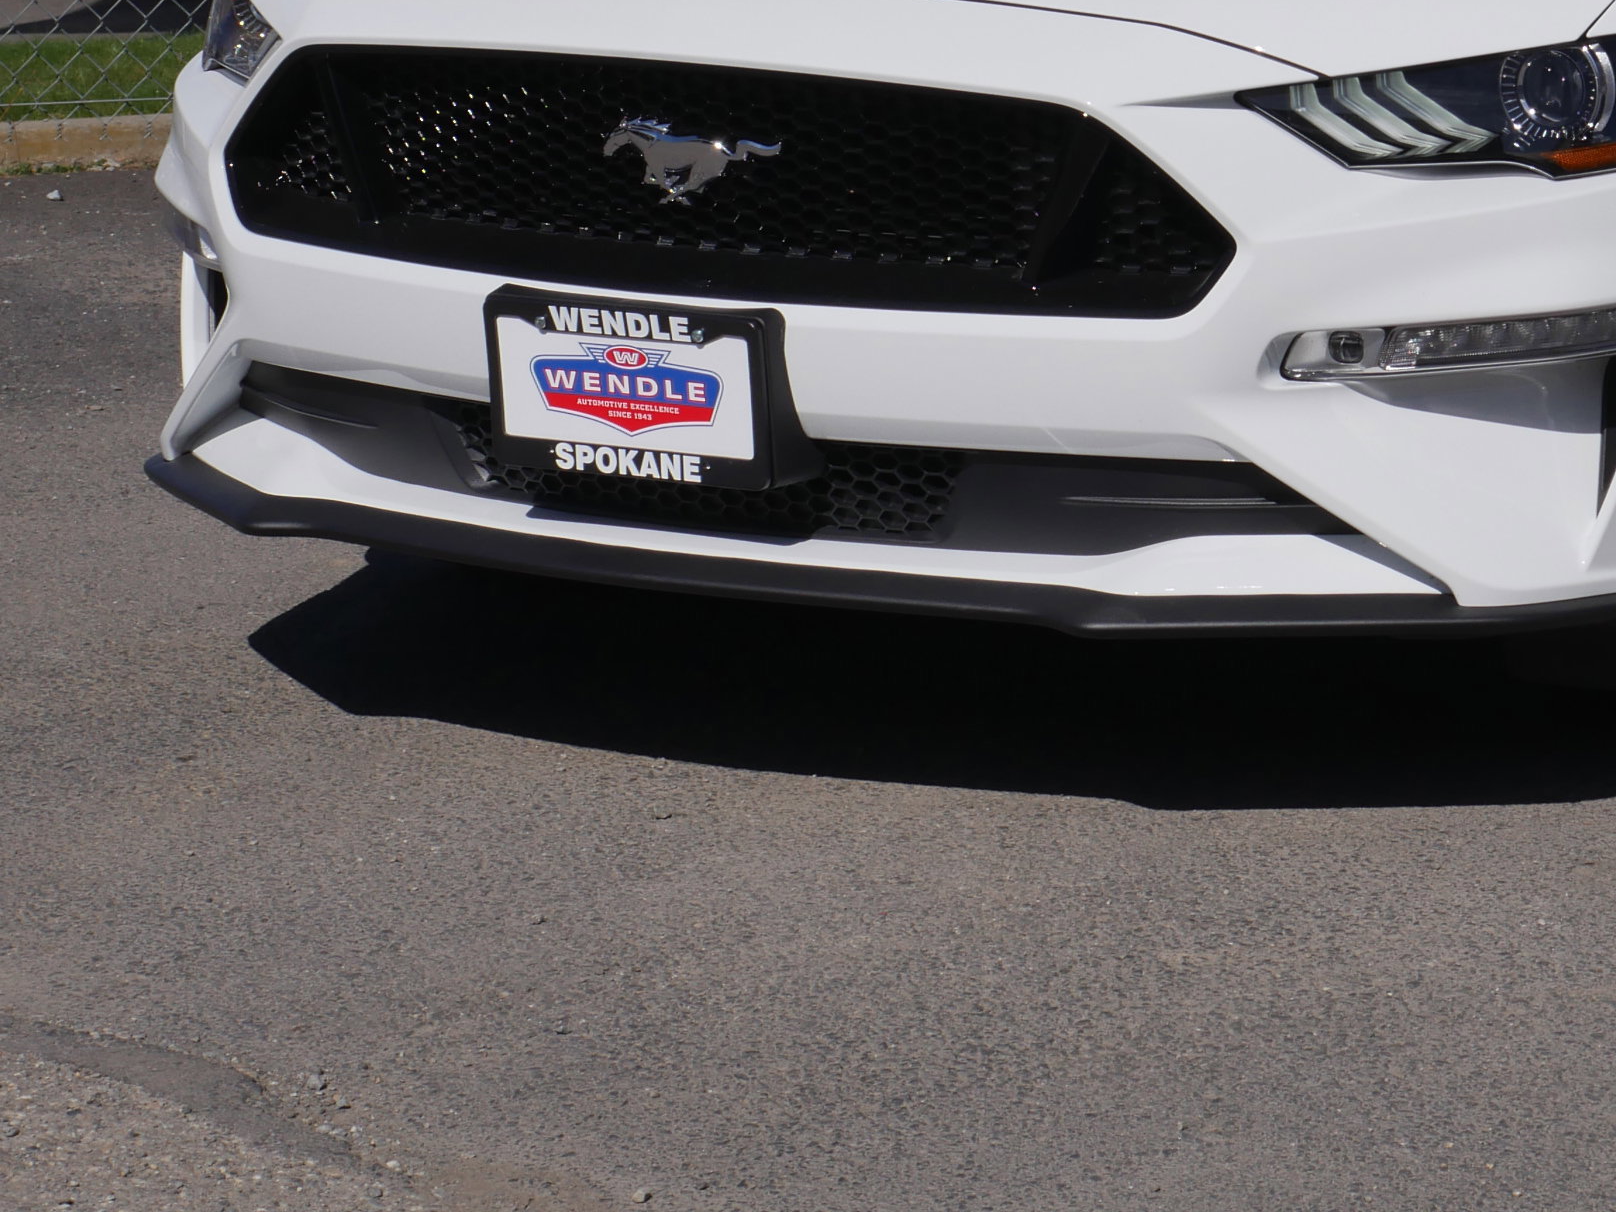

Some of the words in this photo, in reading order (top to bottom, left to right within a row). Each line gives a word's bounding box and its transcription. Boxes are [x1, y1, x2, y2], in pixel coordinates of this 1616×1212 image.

[548, 305, 692, 343] WENDLE
[613, 350, 639, 365] W
[544, 368, 707, 402] WENDLE
[577, 398, 628, 409] AUTOMOTIVE
[630, 403, 680, 415] EXCELLENCE
[608, 410, 632, 419] SINCE
[554, 442, 702, 483] SPOKANE
